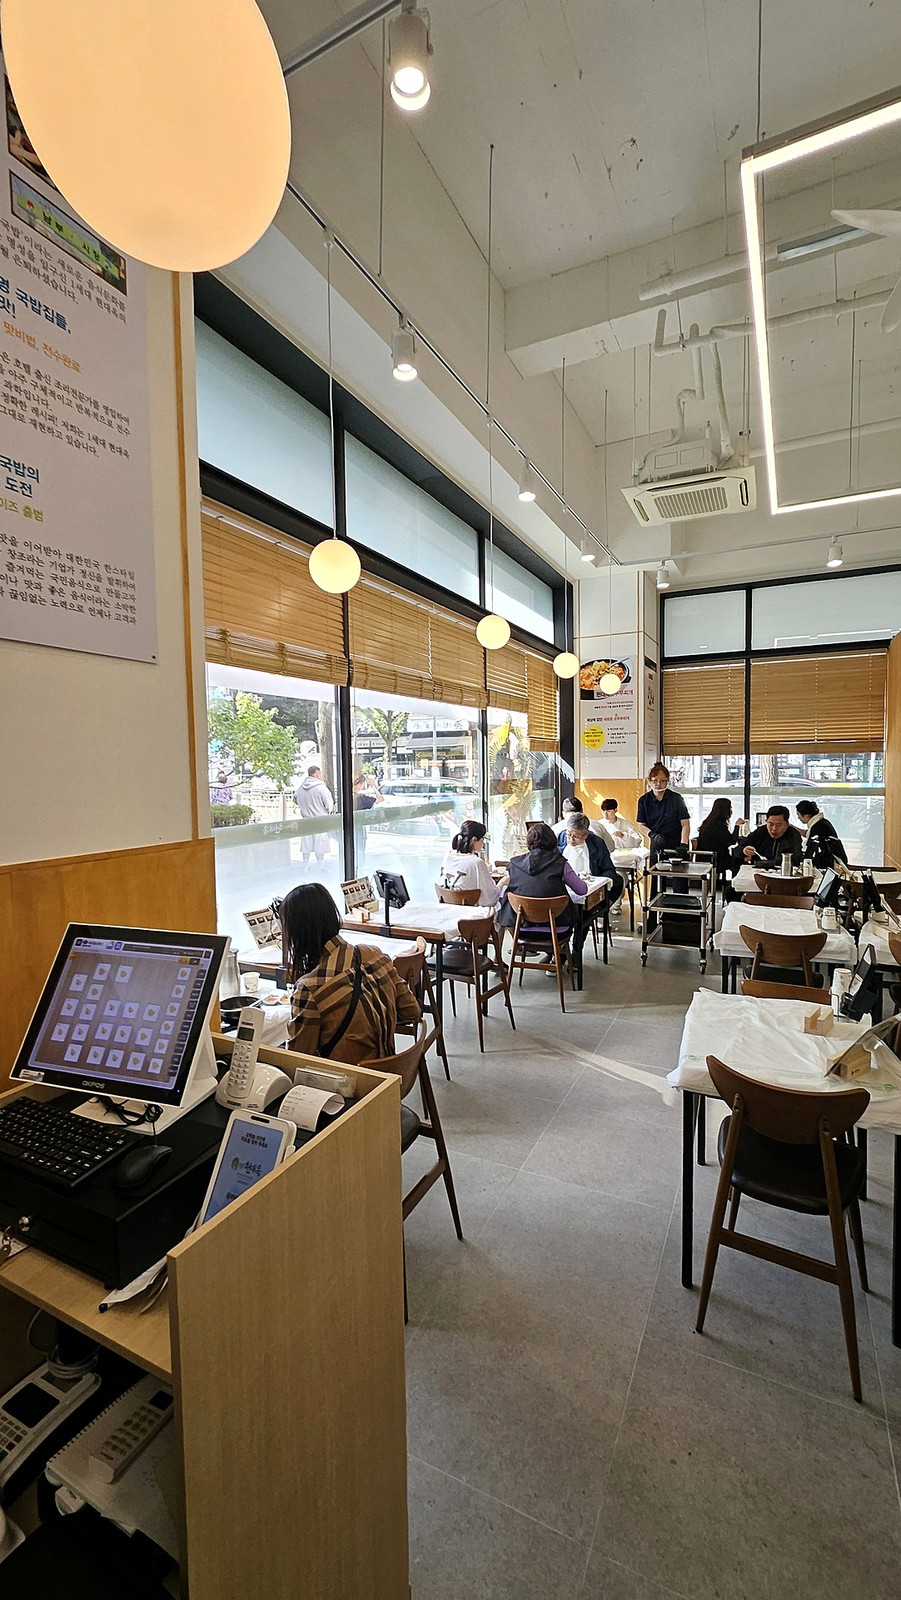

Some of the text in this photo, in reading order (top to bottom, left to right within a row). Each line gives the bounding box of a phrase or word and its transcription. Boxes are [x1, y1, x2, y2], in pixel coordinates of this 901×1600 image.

[6, 235, 36, 263] 명성을
[71, 280, 92, 301] 1세대
[95, 296, 126, 324] 현대옥의
[12, 254, 79, 305] 은퇴하셨습니다.
[57, 258, 83, 282] 새로운
[87, 279, 126, 312] 음식문화를
[41, 342, 81, 374] 전수완료
[3, 379, 52, 411] 과학입니다.
[8, 369, 28, 384] 아주
[30, 379, 73, 408] 구체적이고
[75, 402, 114, 429] 반복적으로
[116, 423, 131, 437] 전수
[13, 358, 31, 376] 호텔
[34, 369, 51, 386] 출신
[54, 379, 100, 411] 조리전문가를
[102, 404, 130, 426] 영입하여
[0, 404, 99, 458] 그대로 재현하고 있습니다.
[1, 391, 28, 412] 정확한
[61, 420, 85, 439] 저희는
[87, 432, 107, 449] 1세대
[108, 442, 130, 460] 현대옥
[0, 454, 40, 484] 국밥의
[4, 476, 33, 499] 도전
[22, 504, 44, 523] 출범
[5, 560, 136, 602] 즐겨먹는 국민음식으로 만들고자
[7, 548, 136, 592] 창조라는 기업가 정신을 발휘하여
[23, 540, 62, 559] 이어받아
[65, 553, 101, 570] 대한민국
[104, 563, 135, 581] 한스타일
[24, 579, 43, 592] 맛과
[48, 584, 66, 598] 좋은
[70, 590, 111, 608] 음식이라는
[114, 601, 137, 615] 소박한
[50, 598, 85, 614] 노력으로
[88, 606, 111, 620] 언제나
[114, 612, 137, 625] 고객과
[82, 1080, 106, 1089] OKPOS
